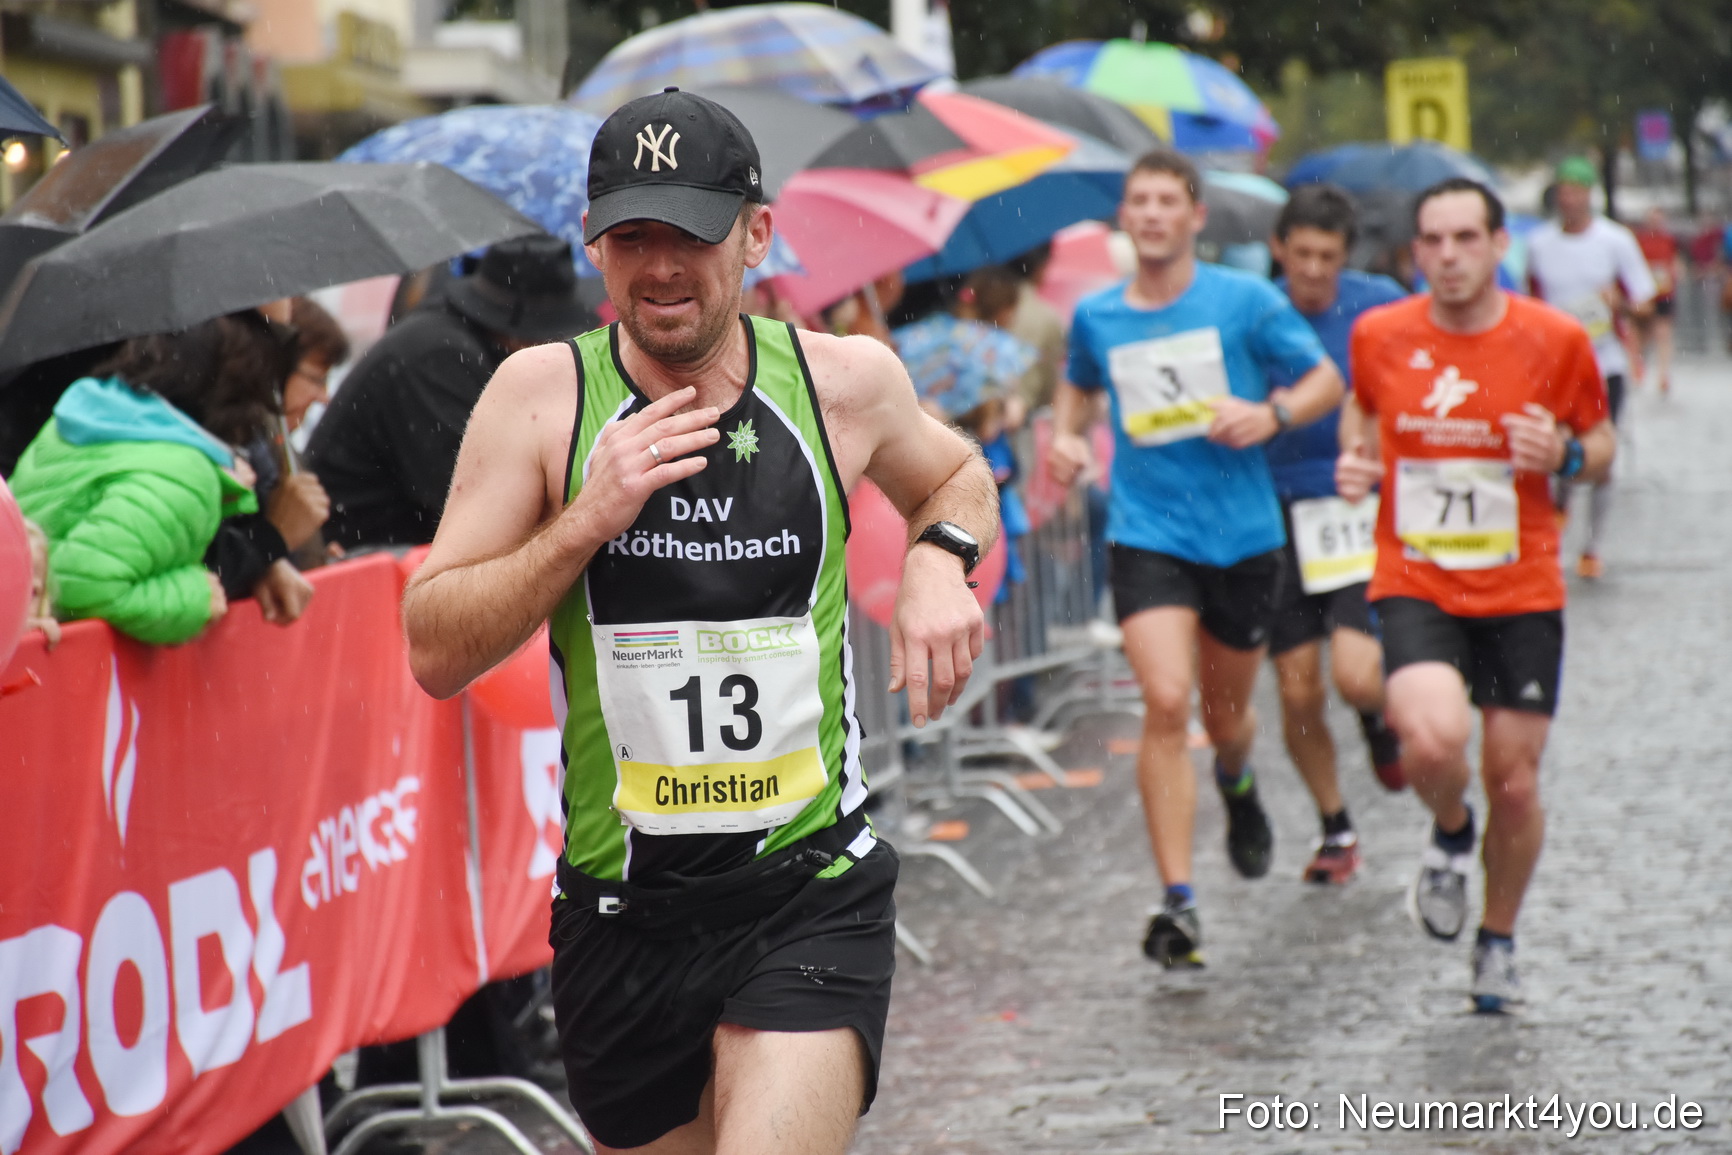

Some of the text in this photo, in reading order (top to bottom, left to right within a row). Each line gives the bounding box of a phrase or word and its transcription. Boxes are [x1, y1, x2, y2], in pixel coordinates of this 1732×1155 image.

[633, 123, 681, 172] NY
[1157, 365, 1183, 403] 3
[670, 496, 733, 523] DAV
[1434, 487, 1475, 525] 71
[608, 529, 801, 562] Röthenbach
[612, 648, 684, 661] NeuerMarkt
[697, 624, 799, 654] BOCK
[697, 649, 802, 664] inspired by smart concepts
[670, 674, 762, 753] 13
[655, 774, 779, 806] Christian
